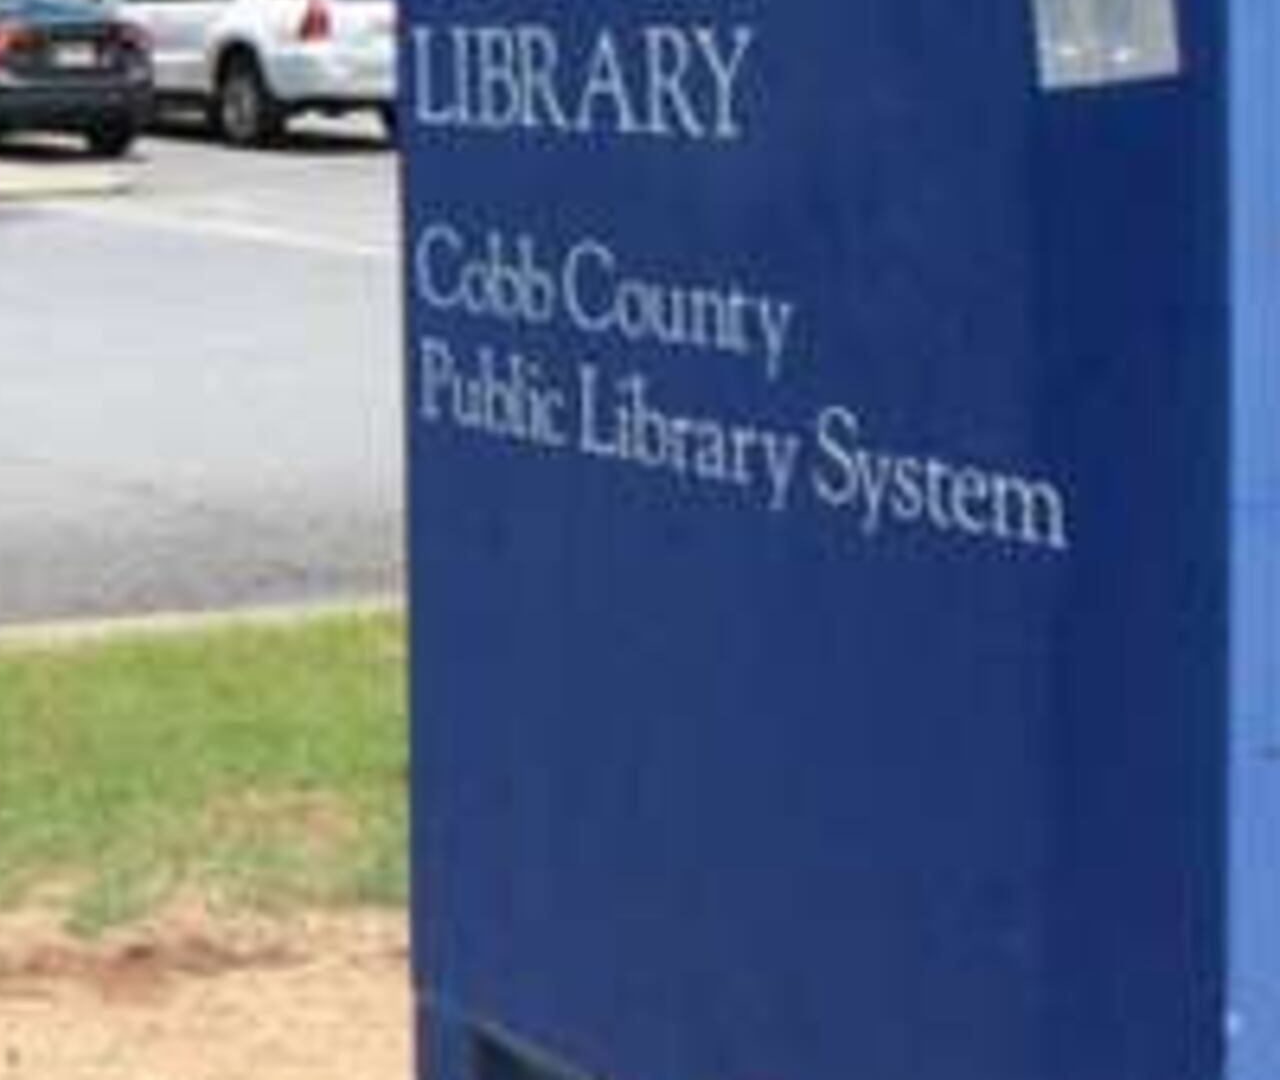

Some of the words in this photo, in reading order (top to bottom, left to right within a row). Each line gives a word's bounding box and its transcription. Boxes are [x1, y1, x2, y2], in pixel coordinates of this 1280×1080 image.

[412, 26, 752, 140] LIBRARY
[414, 224, 556, 322] Cobb
[562, 240, 794, 380] County
[418, 336, 566, 448] Public
[580, 362, 804, 513] Library
[814, 404, 1070, 550] System
